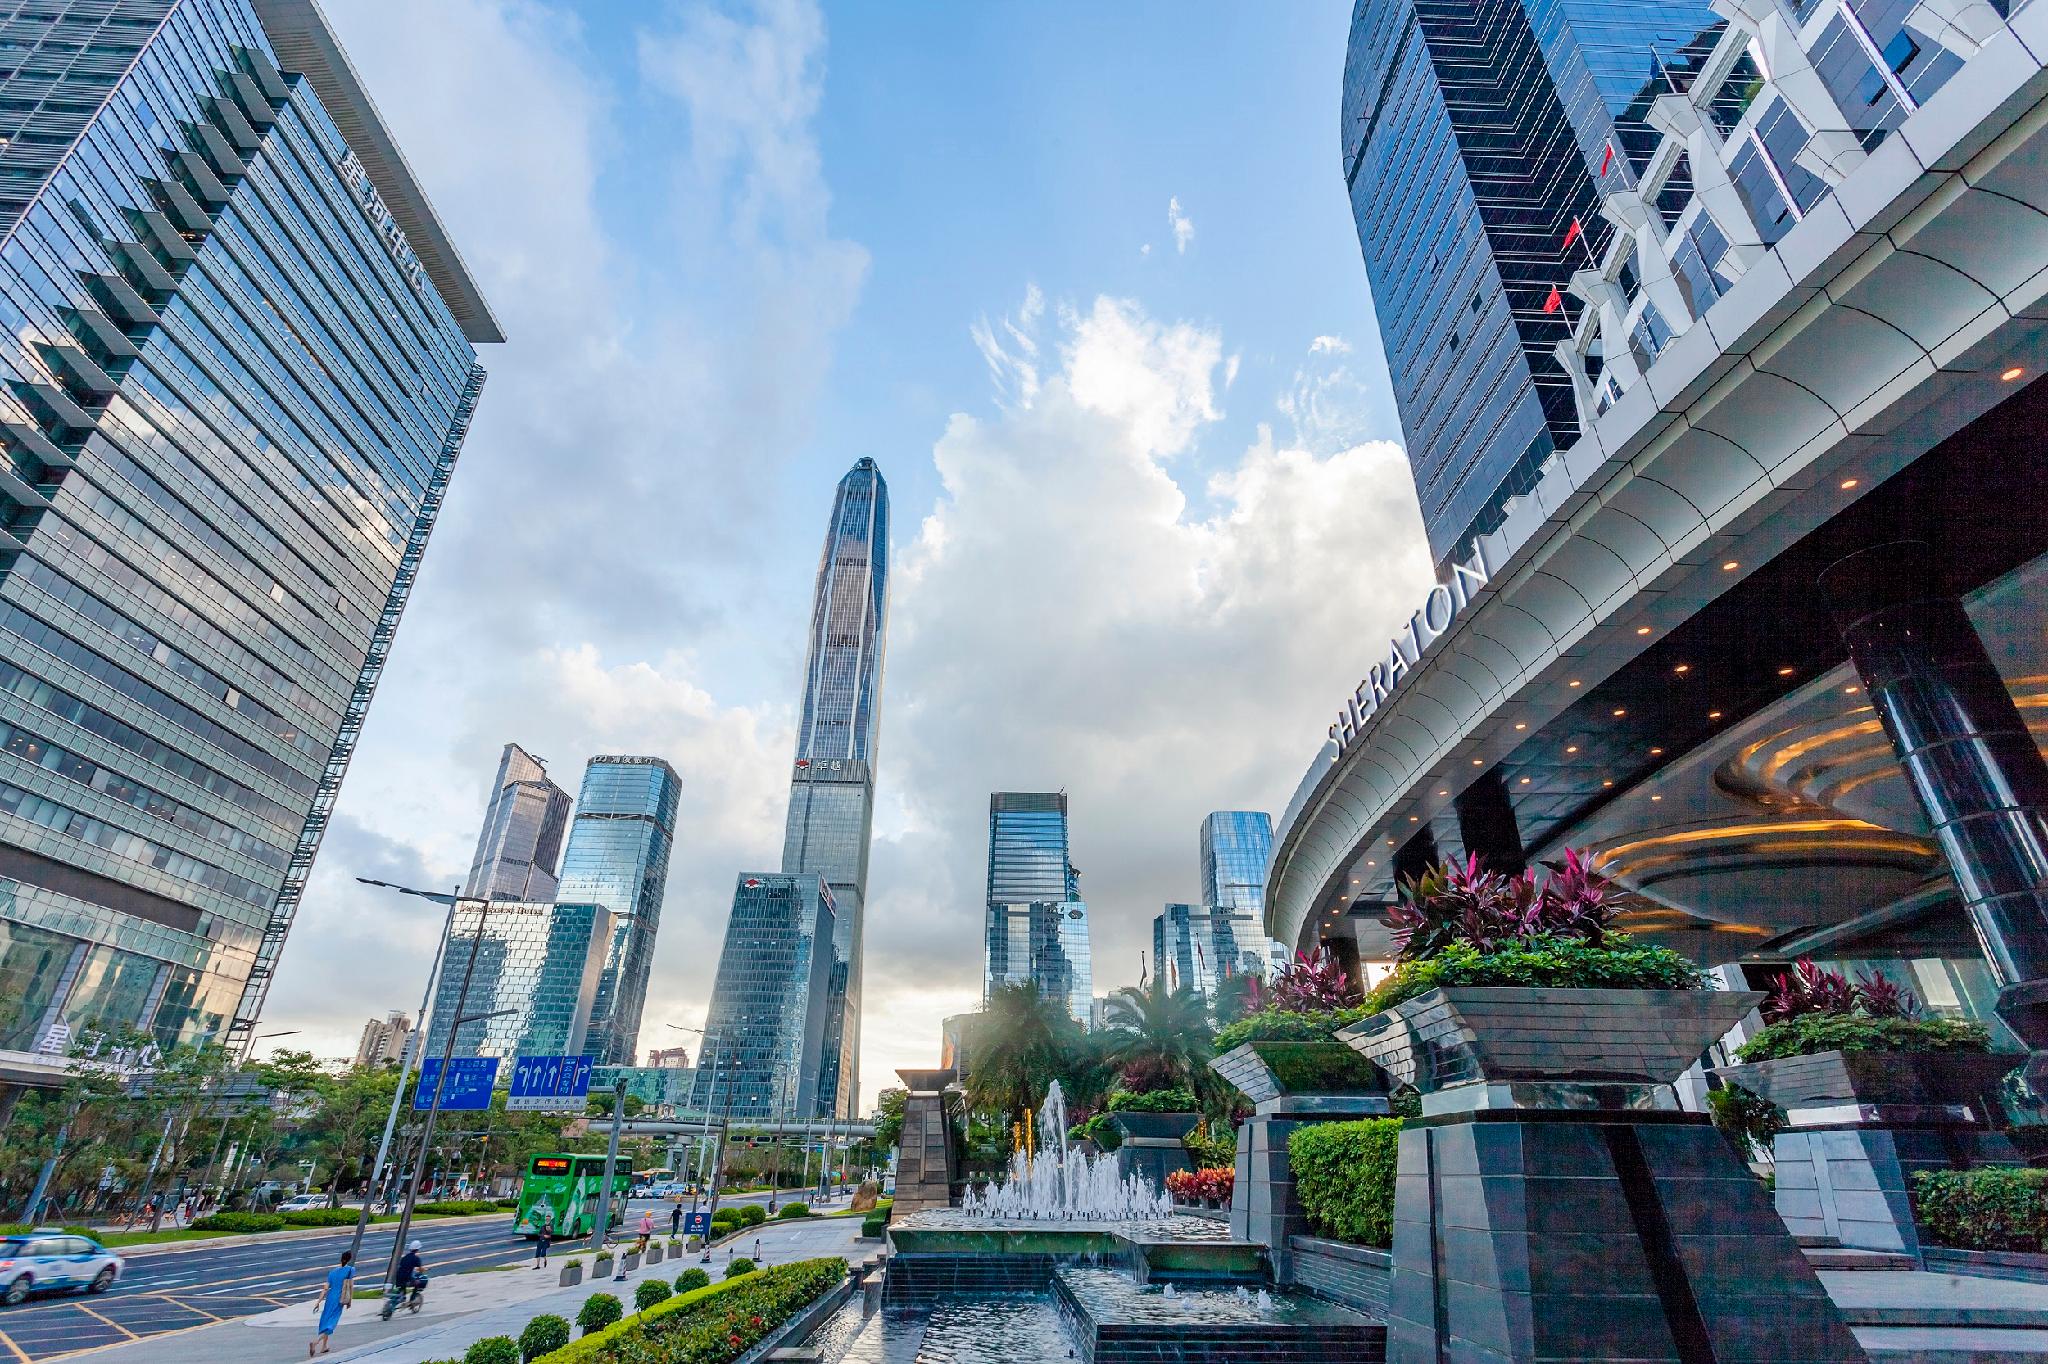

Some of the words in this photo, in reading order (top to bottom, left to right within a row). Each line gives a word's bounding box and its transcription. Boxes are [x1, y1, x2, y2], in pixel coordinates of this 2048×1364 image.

[338, 150, 425, 292] 星河中心
[1327, 536, 1491, 763] SHERATON
[611, 756, 654, 765] 浦发银行
[816, 760, 841, 771] 卓越
